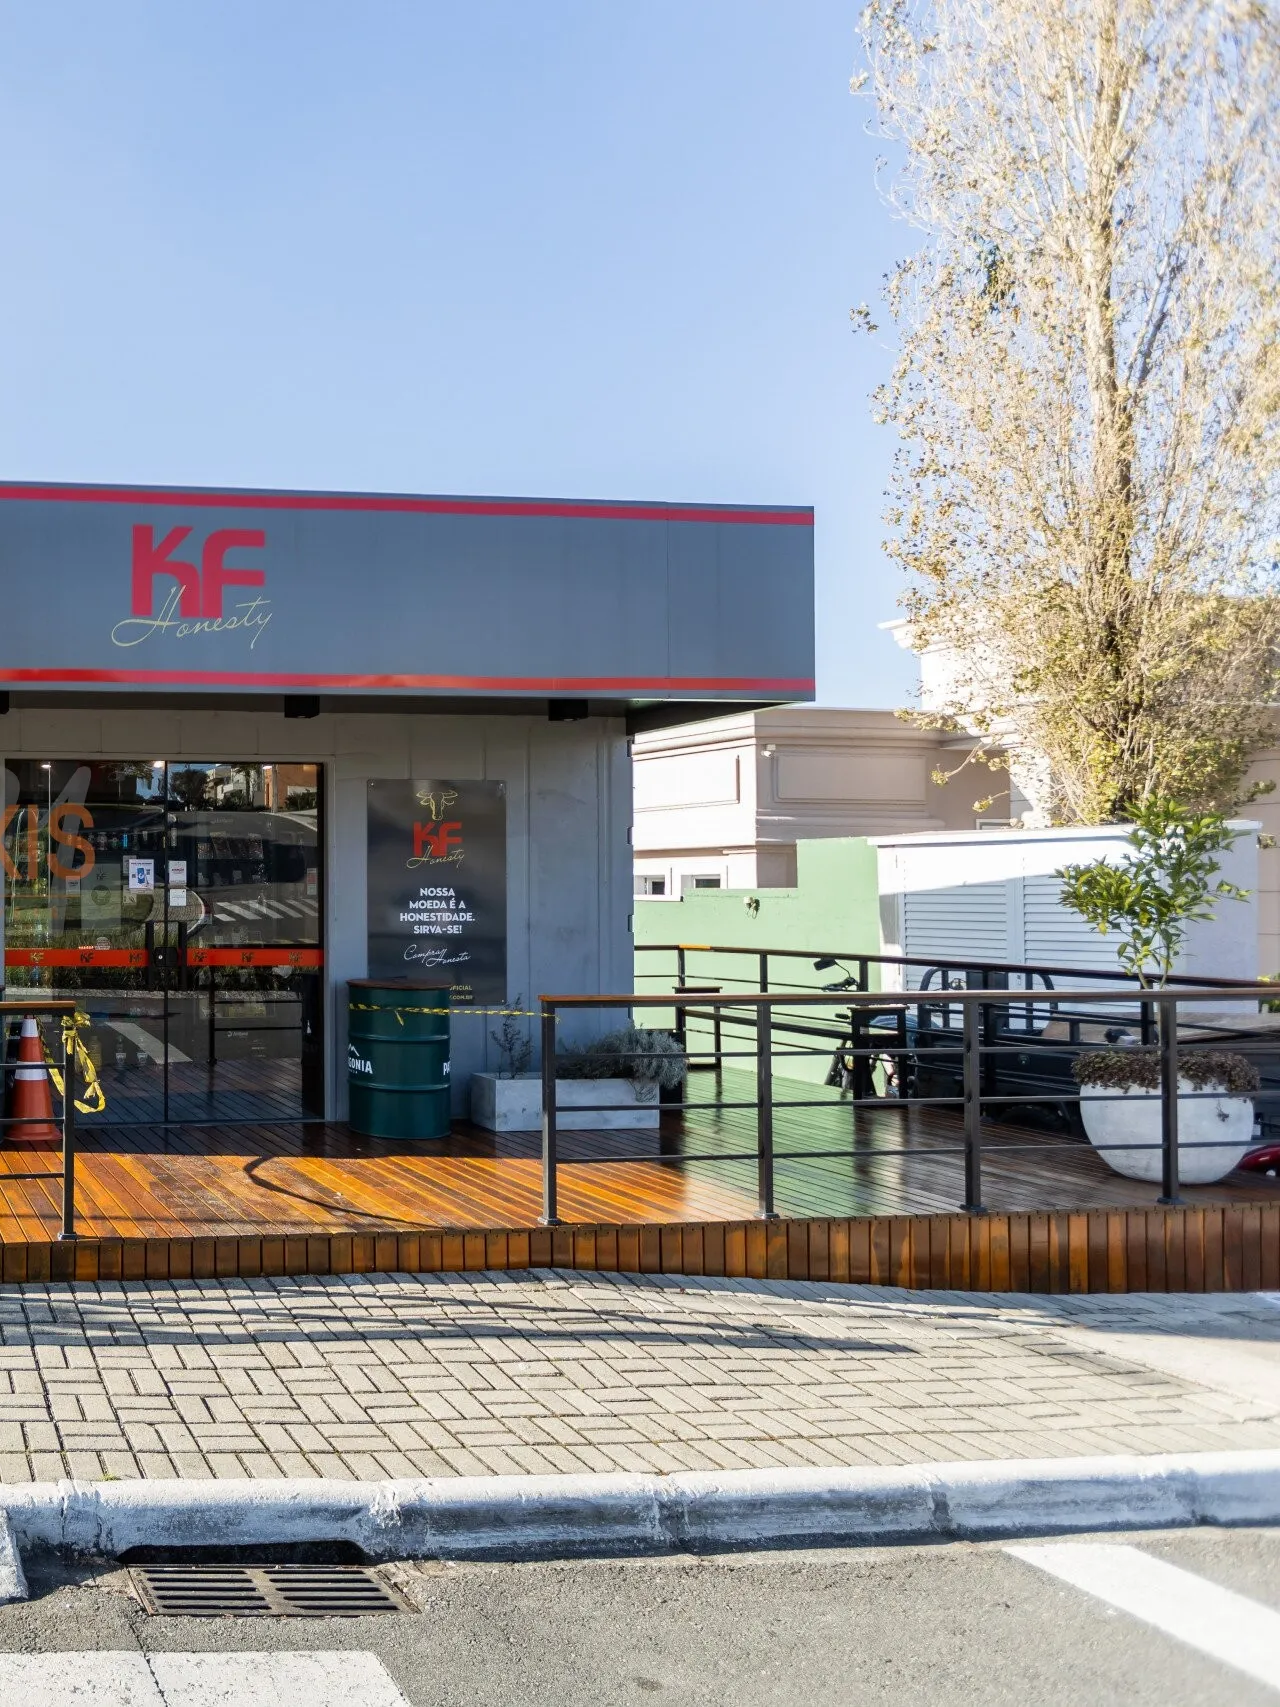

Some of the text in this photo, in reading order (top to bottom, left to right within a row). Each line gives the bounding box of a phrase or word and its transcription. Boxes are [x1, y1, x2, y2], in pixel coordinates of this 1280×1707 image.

[131, 524, 265, 618] KF
[112, 585, 272, 649] Honesty
[413, 821, 462, 857] KF
[406, 845, 465, 868] Honesty
[420, 888, 455, 896] NOSSA
[409, 898, 466, 909] MOEDA É A
[400, 913, 475, 921] HONESTIDADE.
[413, 925, 462, 934] SIRVA-SE!
[80, 952, 95, 962] KF
[404, 944, 441, 963] Compra
